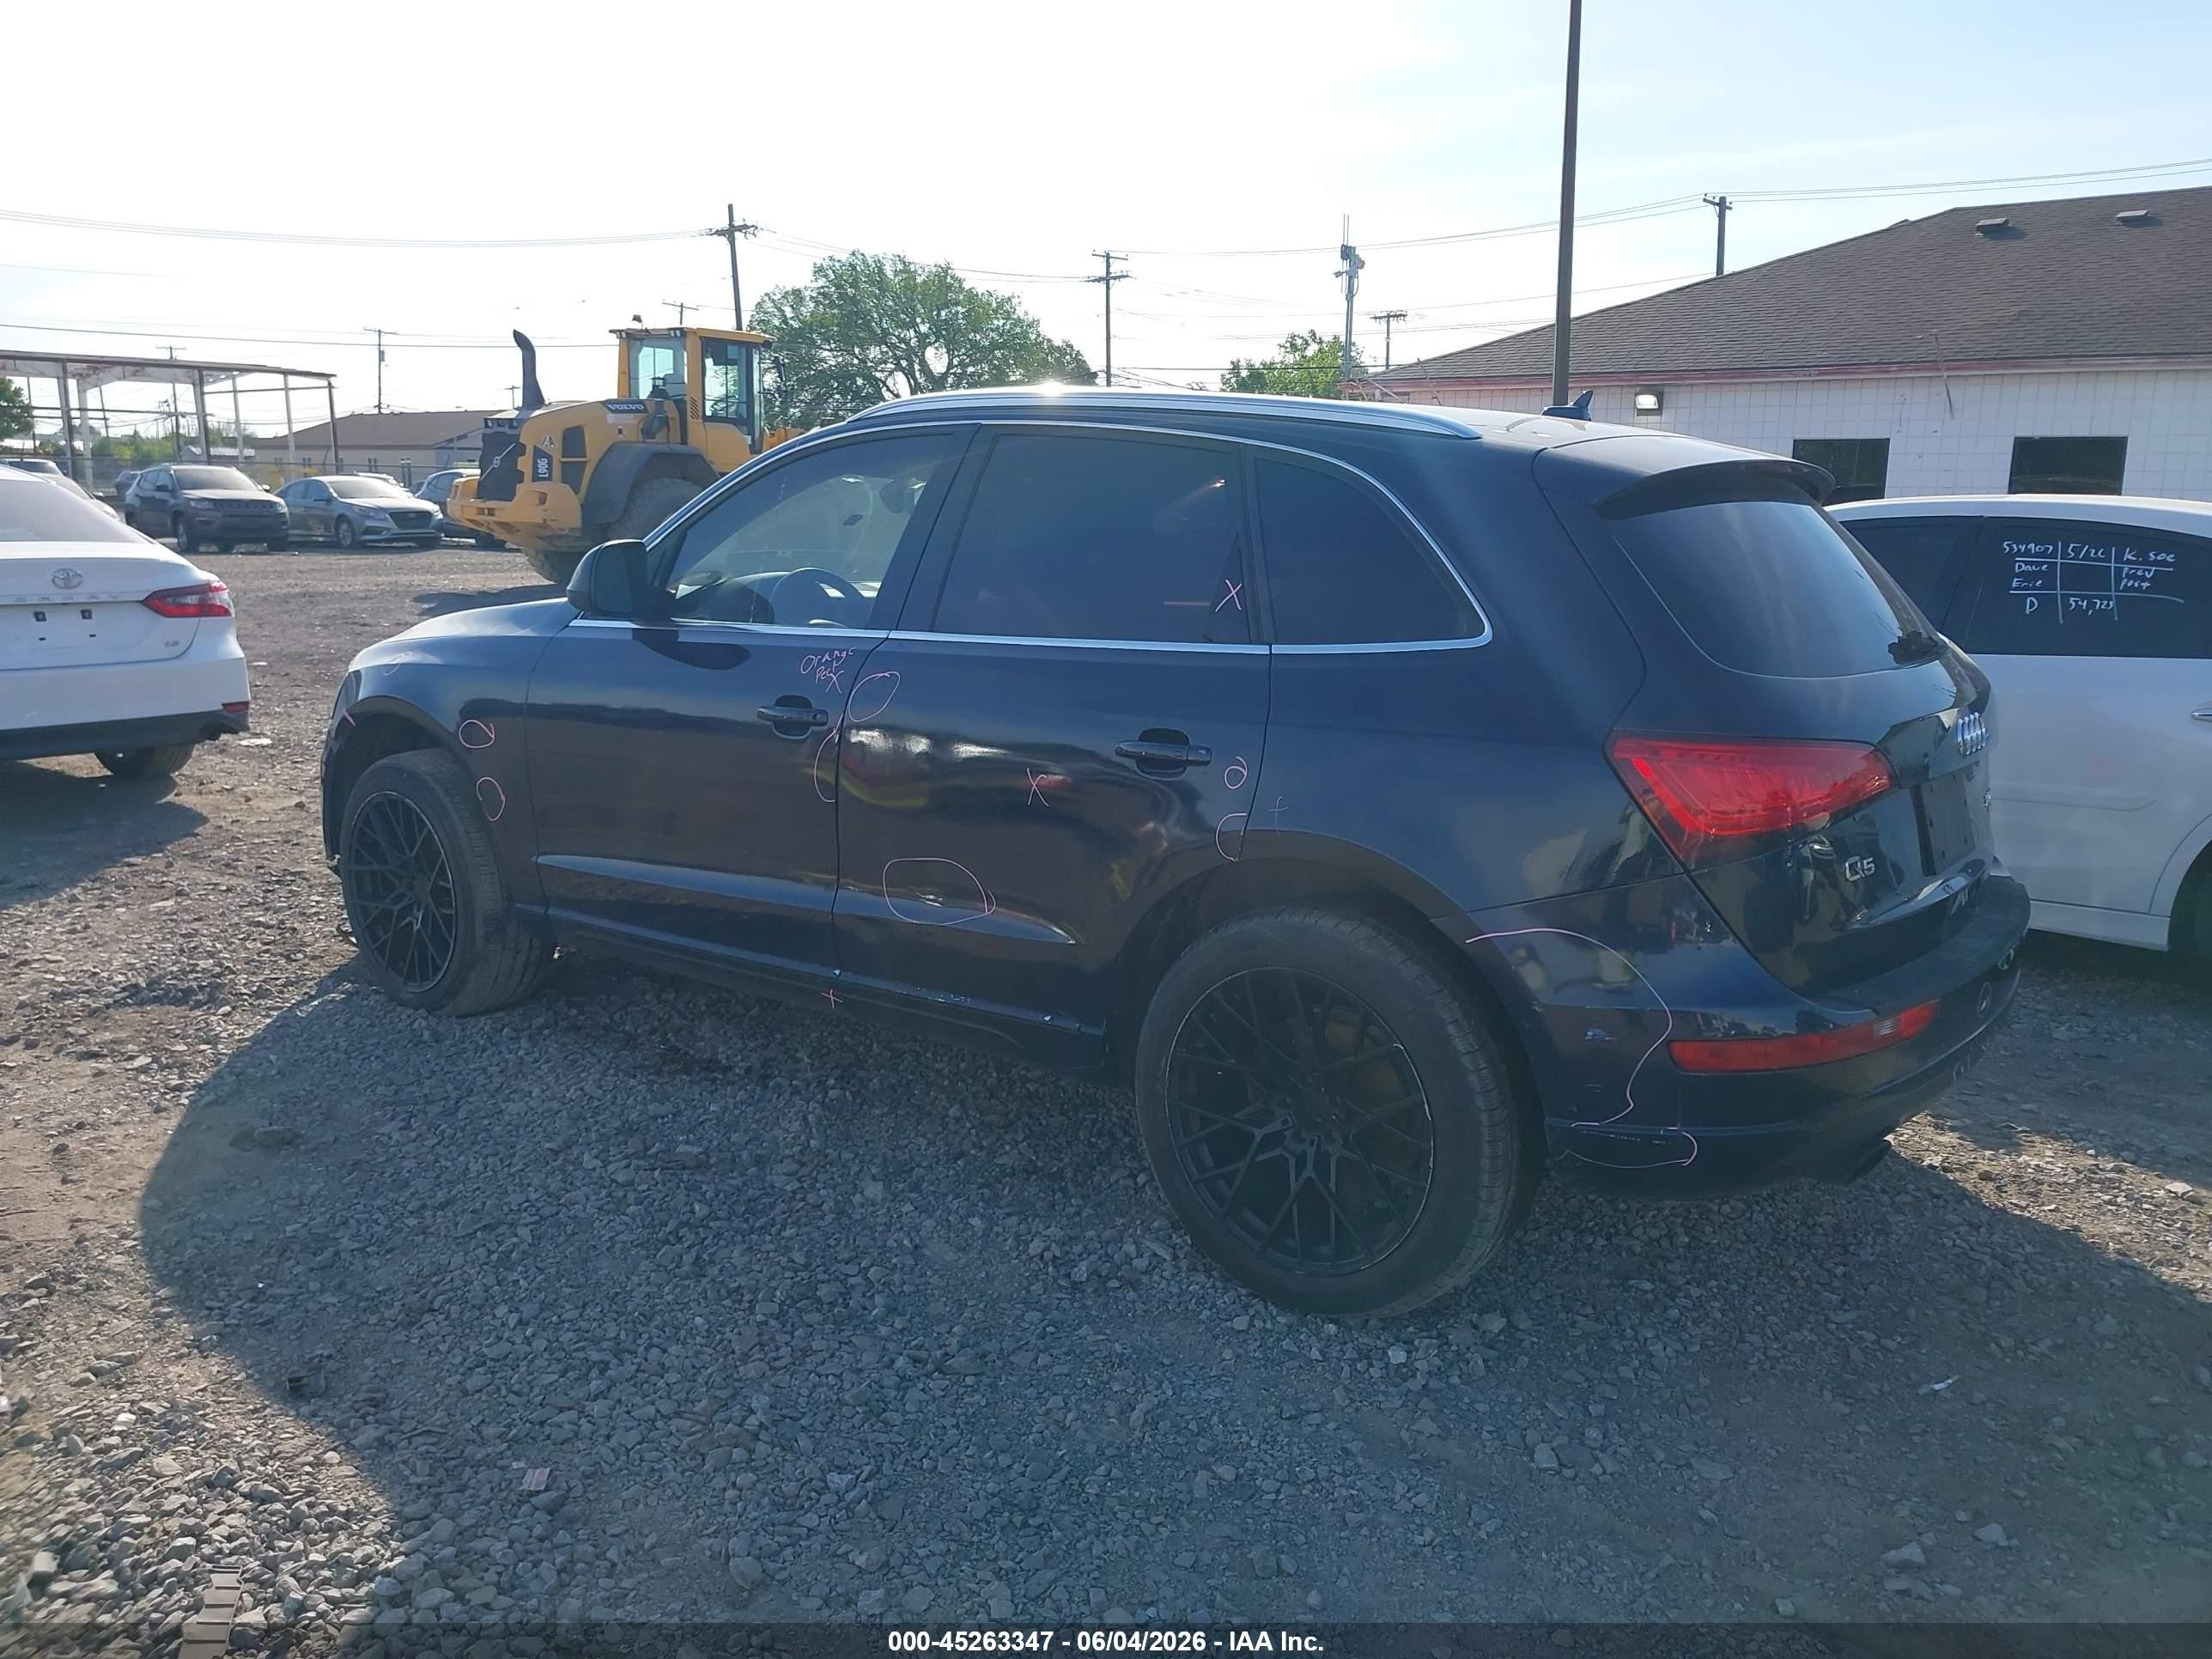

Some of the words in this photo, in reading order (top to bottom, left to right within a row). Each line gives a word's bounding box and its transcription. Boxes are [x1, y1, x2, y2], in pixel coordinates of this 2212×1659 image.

[537, 458, 550, 478] L90G
[2014, 562, 2049, 574] Dave
[2025, 597, 2039, 615] D
[1845, 856, 1875, 882] Q5
